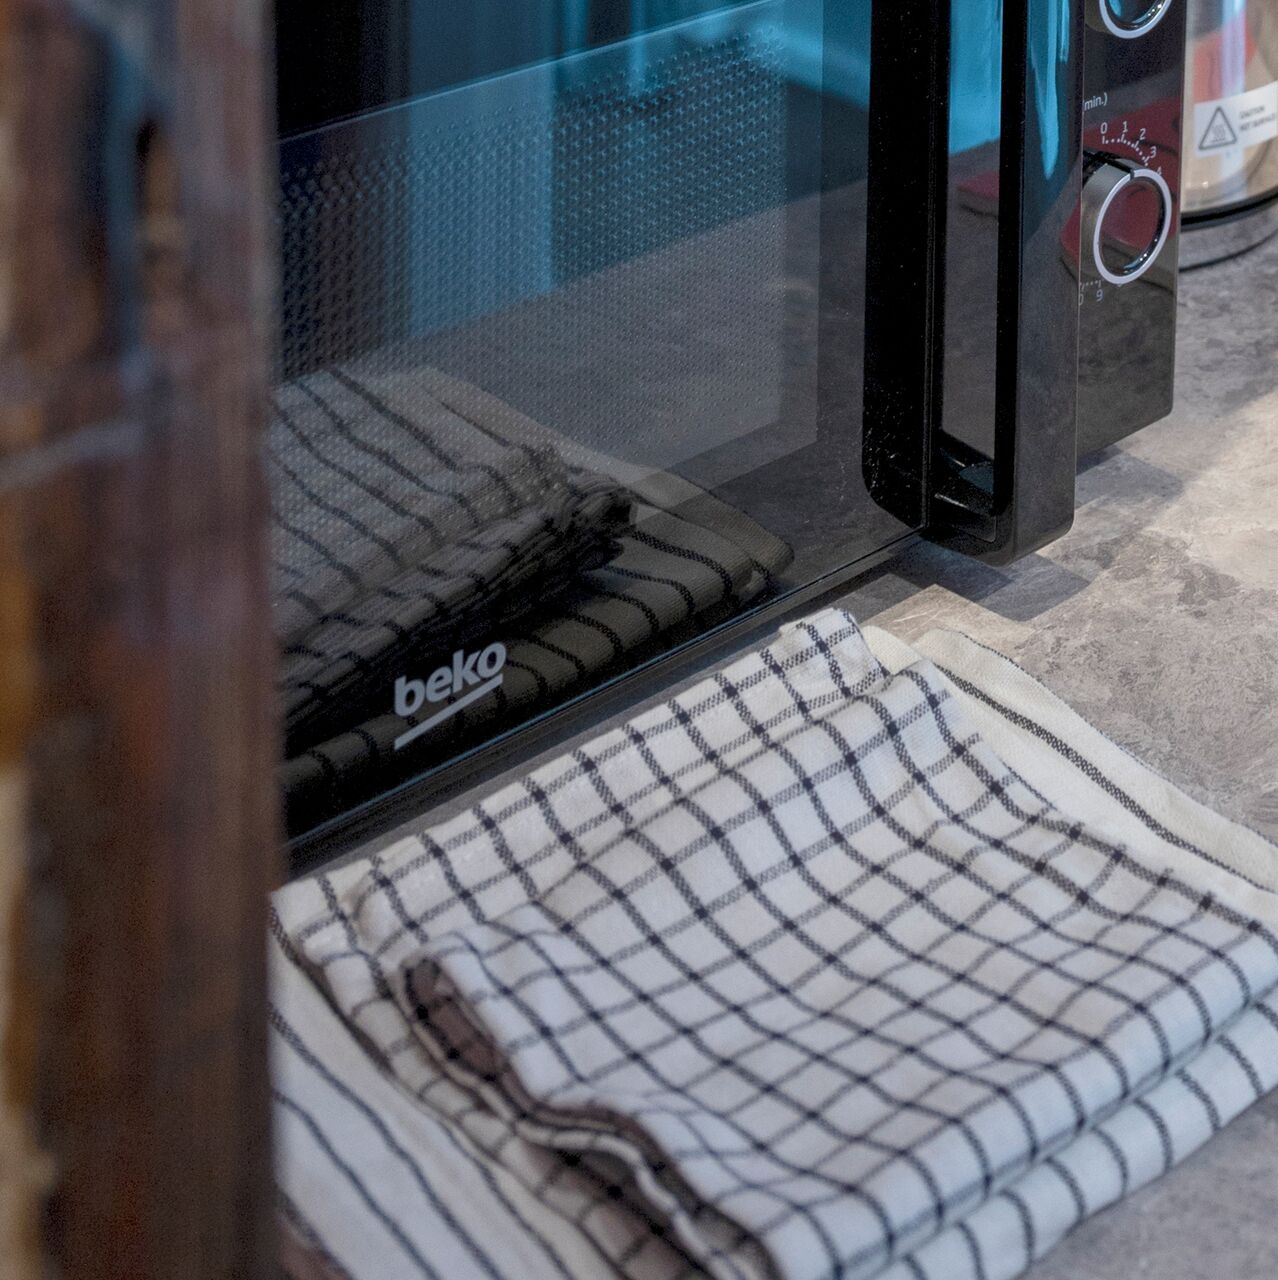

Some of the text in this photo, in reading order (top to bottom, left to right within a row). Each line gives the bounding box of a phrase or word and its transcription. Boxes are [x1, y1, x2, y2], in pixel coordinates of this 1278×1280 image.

[1084, 91, 1108, 111] min.)
[1100, 122, 1108, 134] 0
[1122, 120, 1129, 133] 1
[1139, 128, 1147, 140] 2
[1150, 146, 1157, 159] 3
[394, 641, 508, 718] beko
